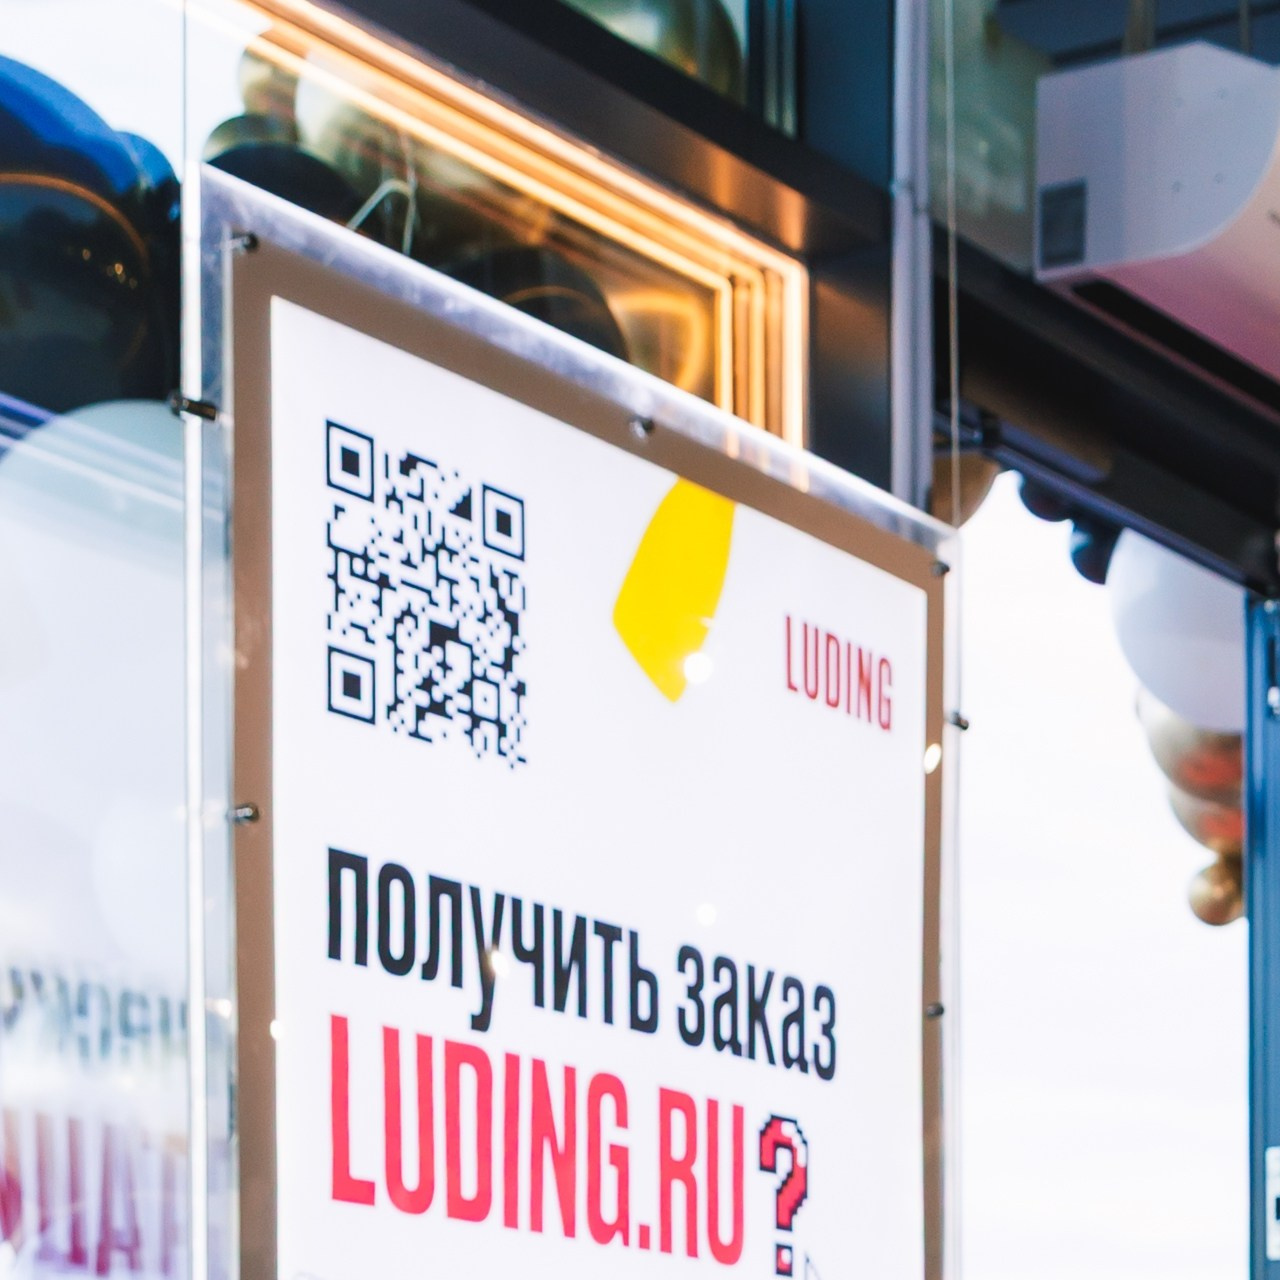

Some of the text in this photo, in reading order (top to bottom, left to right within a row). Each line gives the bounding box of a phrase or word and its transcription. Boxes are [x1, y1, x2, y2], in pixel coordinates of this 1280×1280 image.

[784, 613, 894, 733] LUDING
[327, 847, 659, 1034] получить
[677, 944, 838, 1082] заказ
